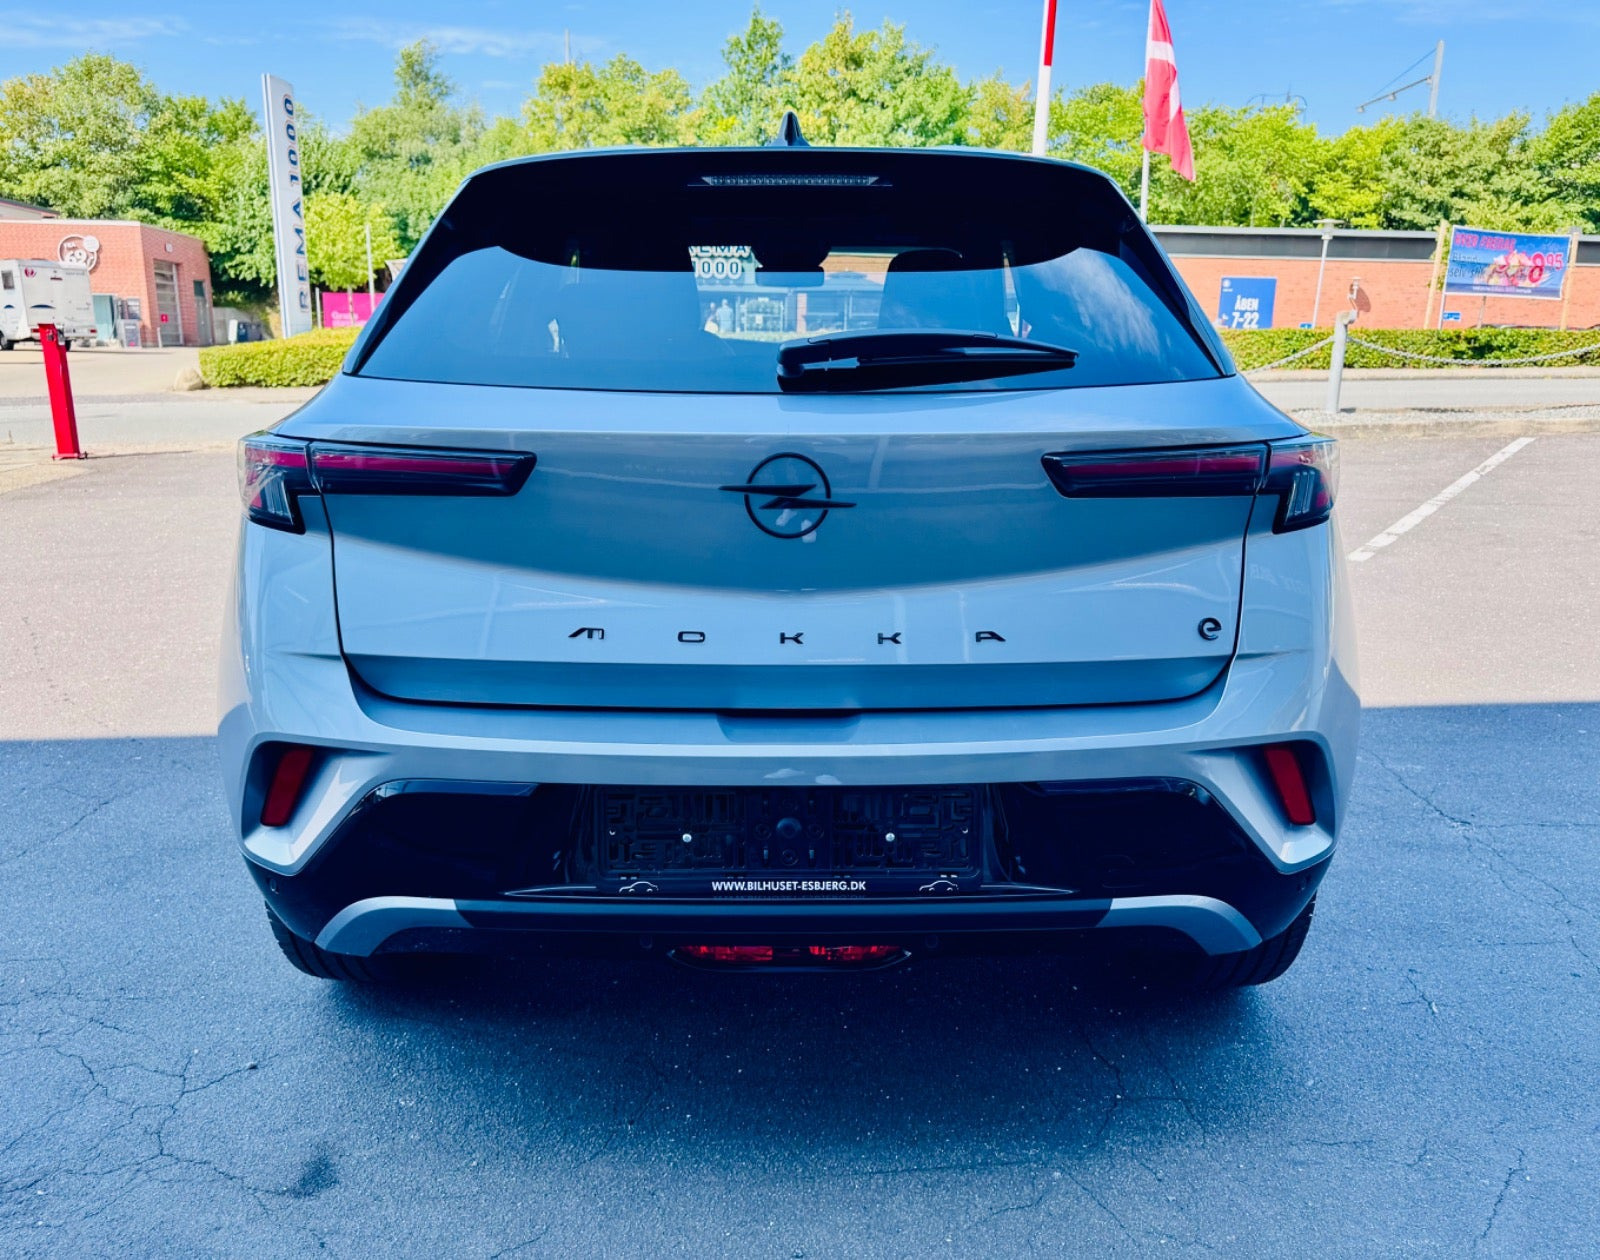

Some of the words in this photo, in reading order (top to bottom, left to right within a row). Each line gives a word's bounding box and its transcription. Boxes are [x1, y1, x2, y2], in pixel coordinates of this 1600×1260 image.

[283, 95, 299, 184] 1000
[292, 200, 309, 310] REMA
[1234, 294, 1259, 311] ÅBEN
[1230, 311, 1259, 329] 7-22
[711, 880, 867, 891] WWW.BILHUSET-ESBJERG.DK
